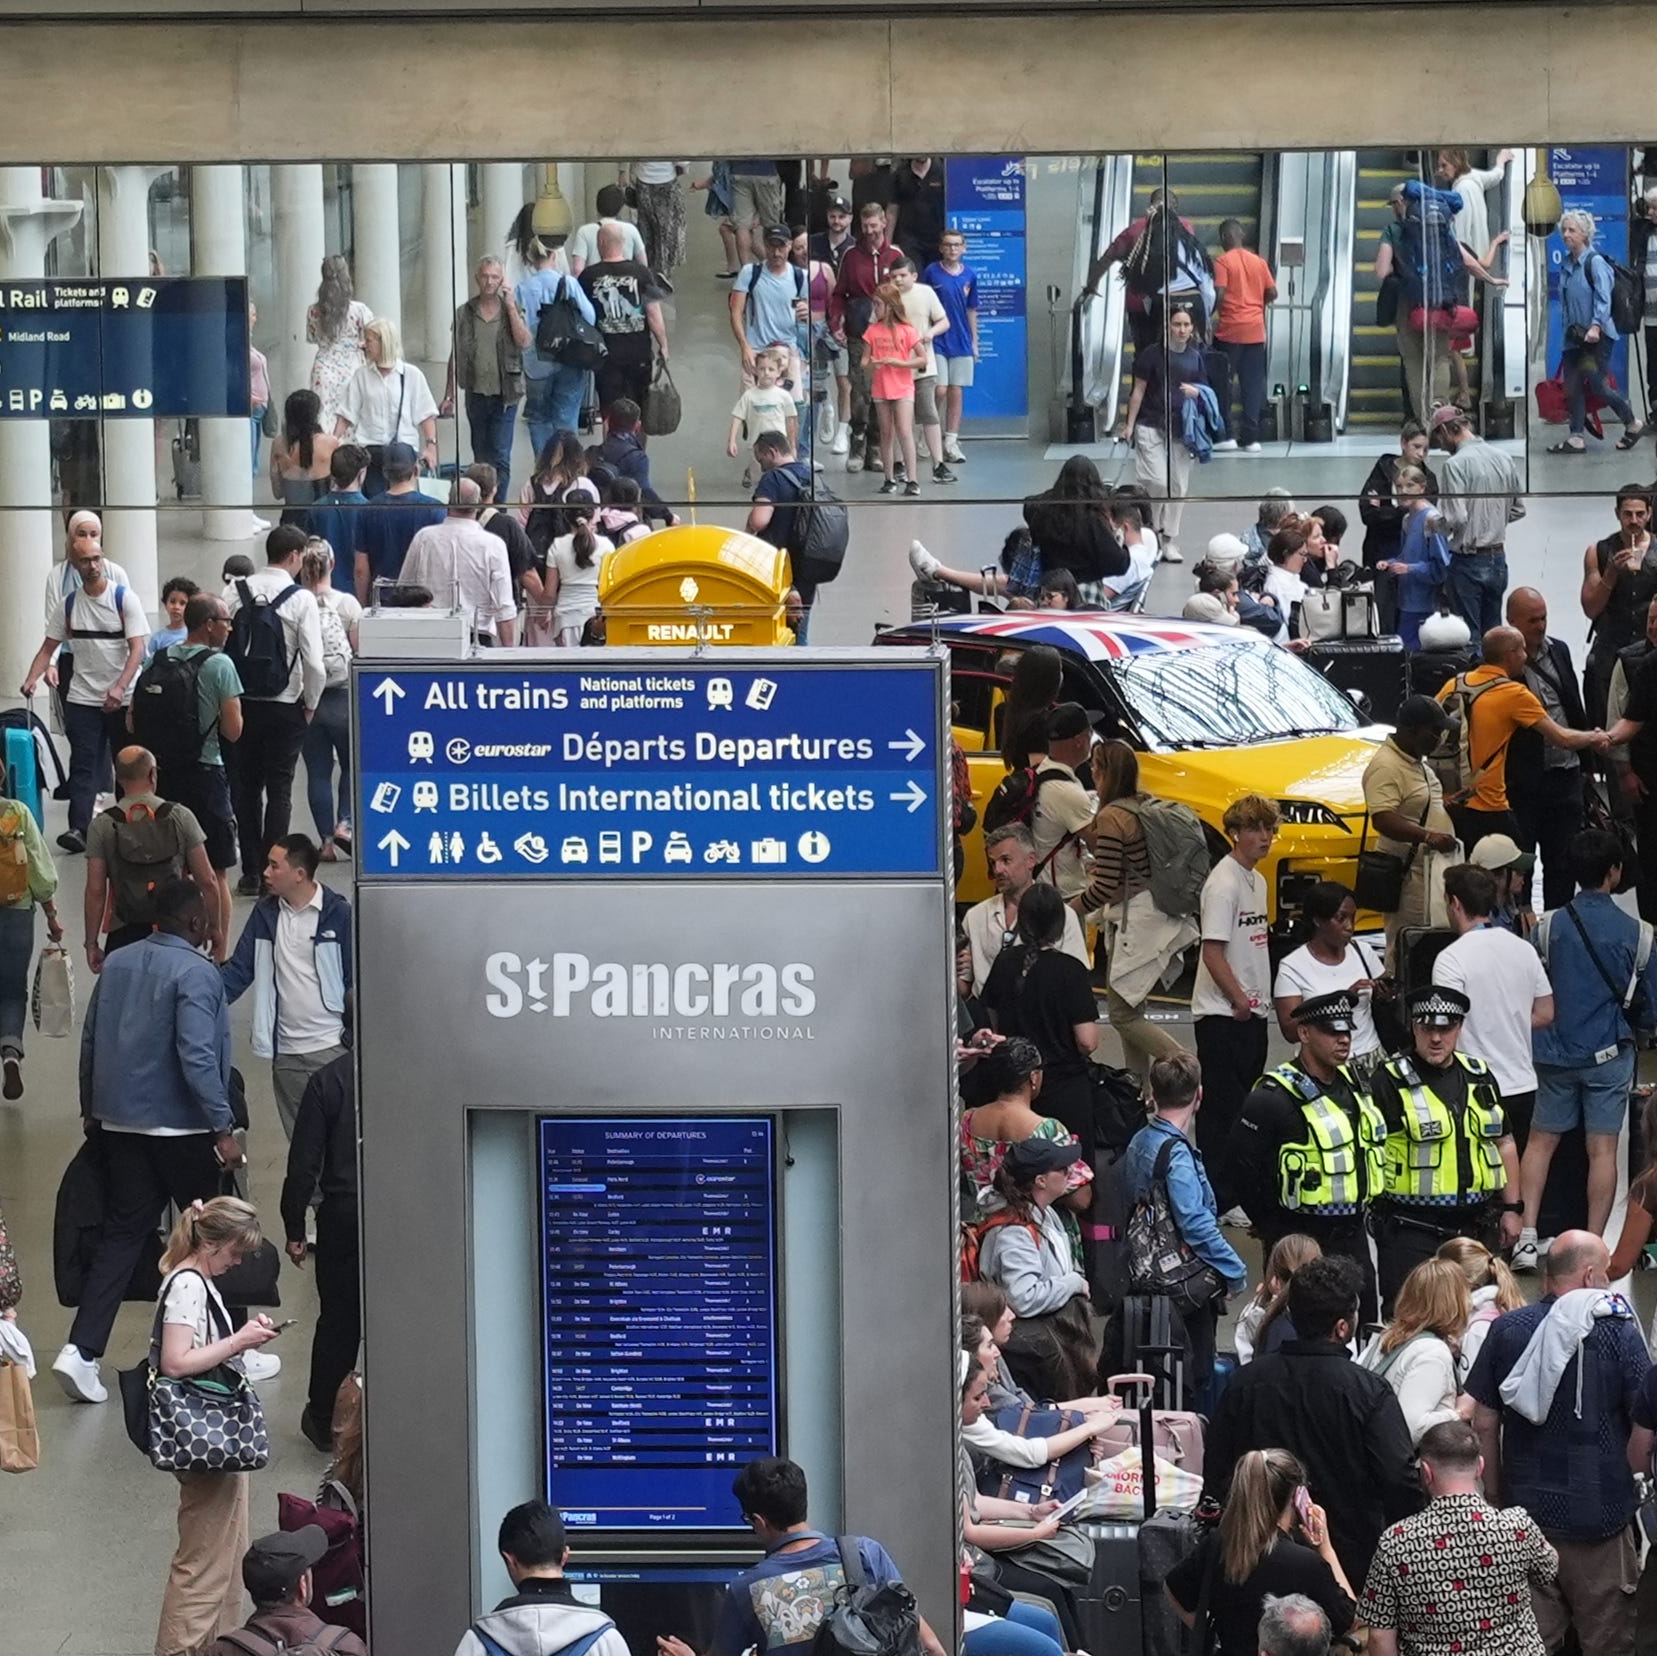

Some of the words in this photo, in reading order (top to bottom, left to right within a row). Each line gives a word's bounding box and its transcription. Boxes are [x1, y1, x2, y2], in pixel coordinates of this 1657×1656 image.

[10, 289, 48, 309] Rail
[54, 287, 86, 298] Tickets
[8, 331, 45, 342] Midland
[46, 331, 70, 342] Road
[647, 624, 734, 641] RENAULT
[580, 677, 642, 693] National
[645, 677, 695, 693] tickets
[424, 681, 469, 711] All
[476, 680, 569, 711] trains
[580, 694, 608, 709] and
[611, 694, 684, 712] platforms
[473, 741, 552, 759] eurostar
[562, 730, 686, 767] Départs
[695, 732, 873, 768] Departures
[449, 782, 549, 812] Billets
[558, 782, 762, 812] International
[768, 782, 876, 812] tickets
[651, 1026, 816, 1040] INTERNATIONAL
[604, 1131, 643, 1140] SUMMARY
[645, 1131, 655, 1140] OF
[657, 1131, 707, 1140] DEPARTURES
[1115, 1483, 1144, 1497] BAC
